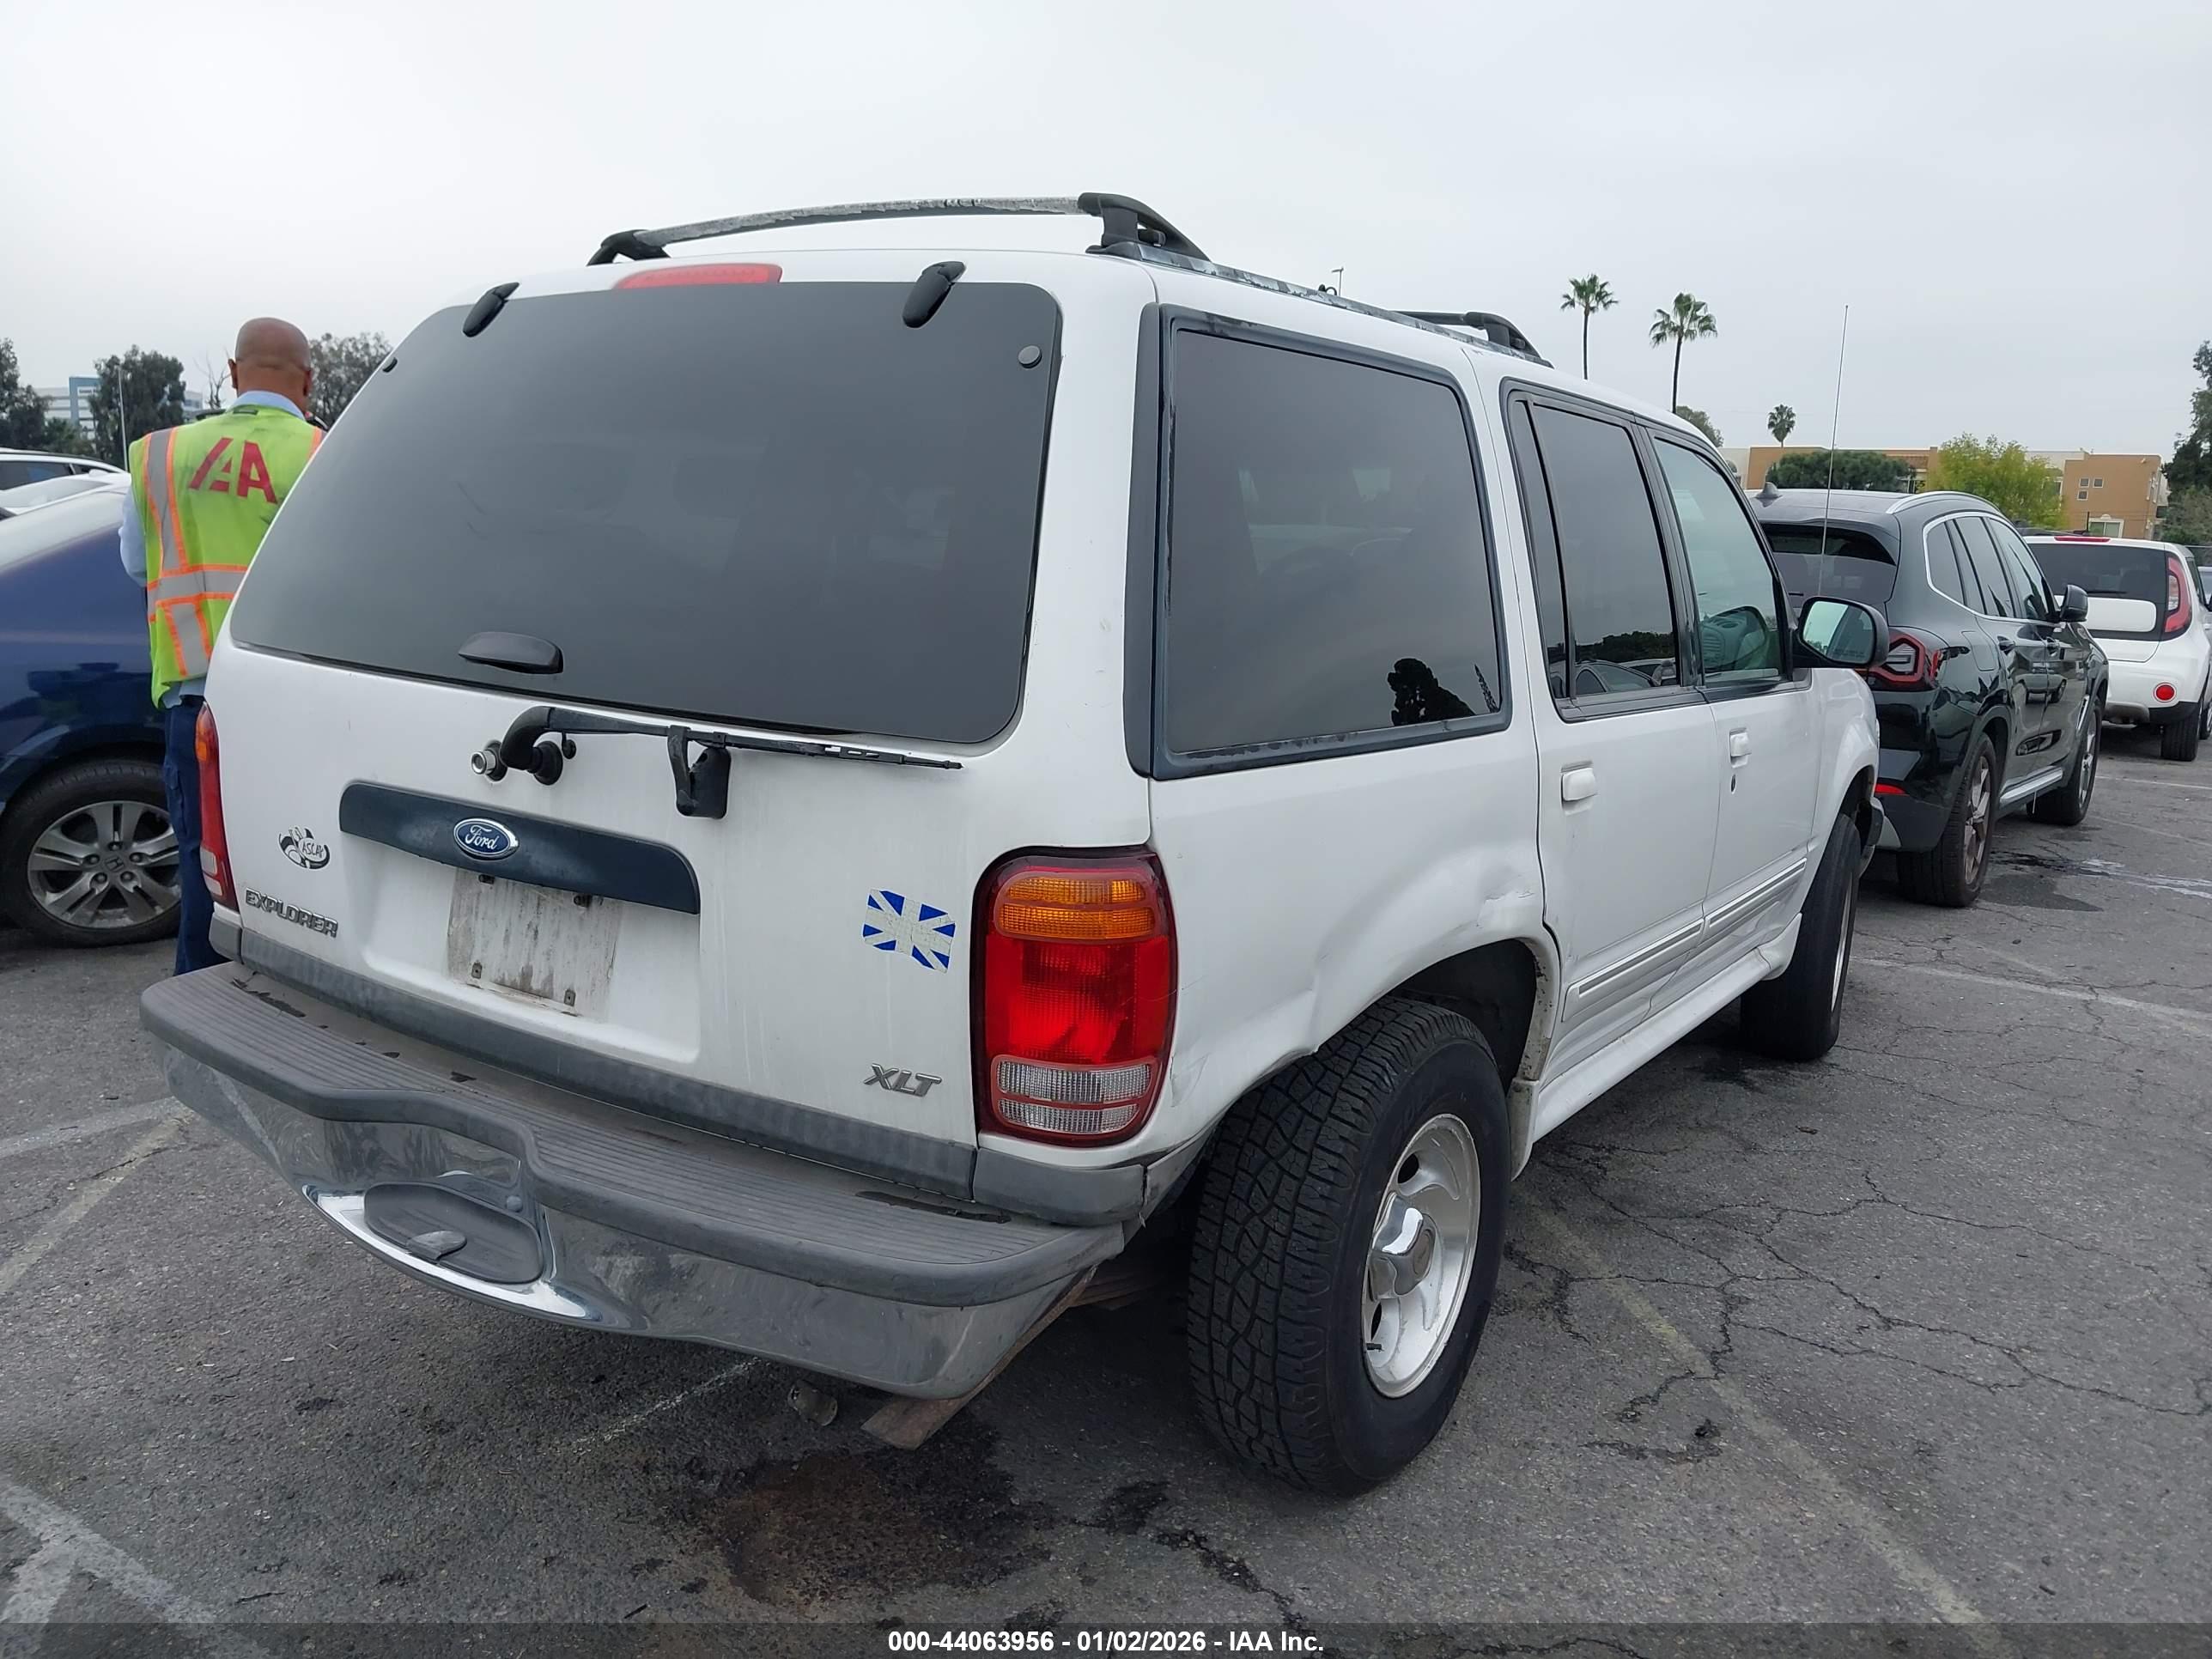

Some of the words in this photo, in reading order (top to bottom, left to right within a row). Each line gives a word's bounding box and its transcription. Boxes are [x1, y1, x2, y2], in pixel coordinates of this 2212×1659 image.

[465, 824, 500, 850] Ford
[246, 886, 338, 939] EXPLORER
[863, 1063, 943, 1097] XLT
